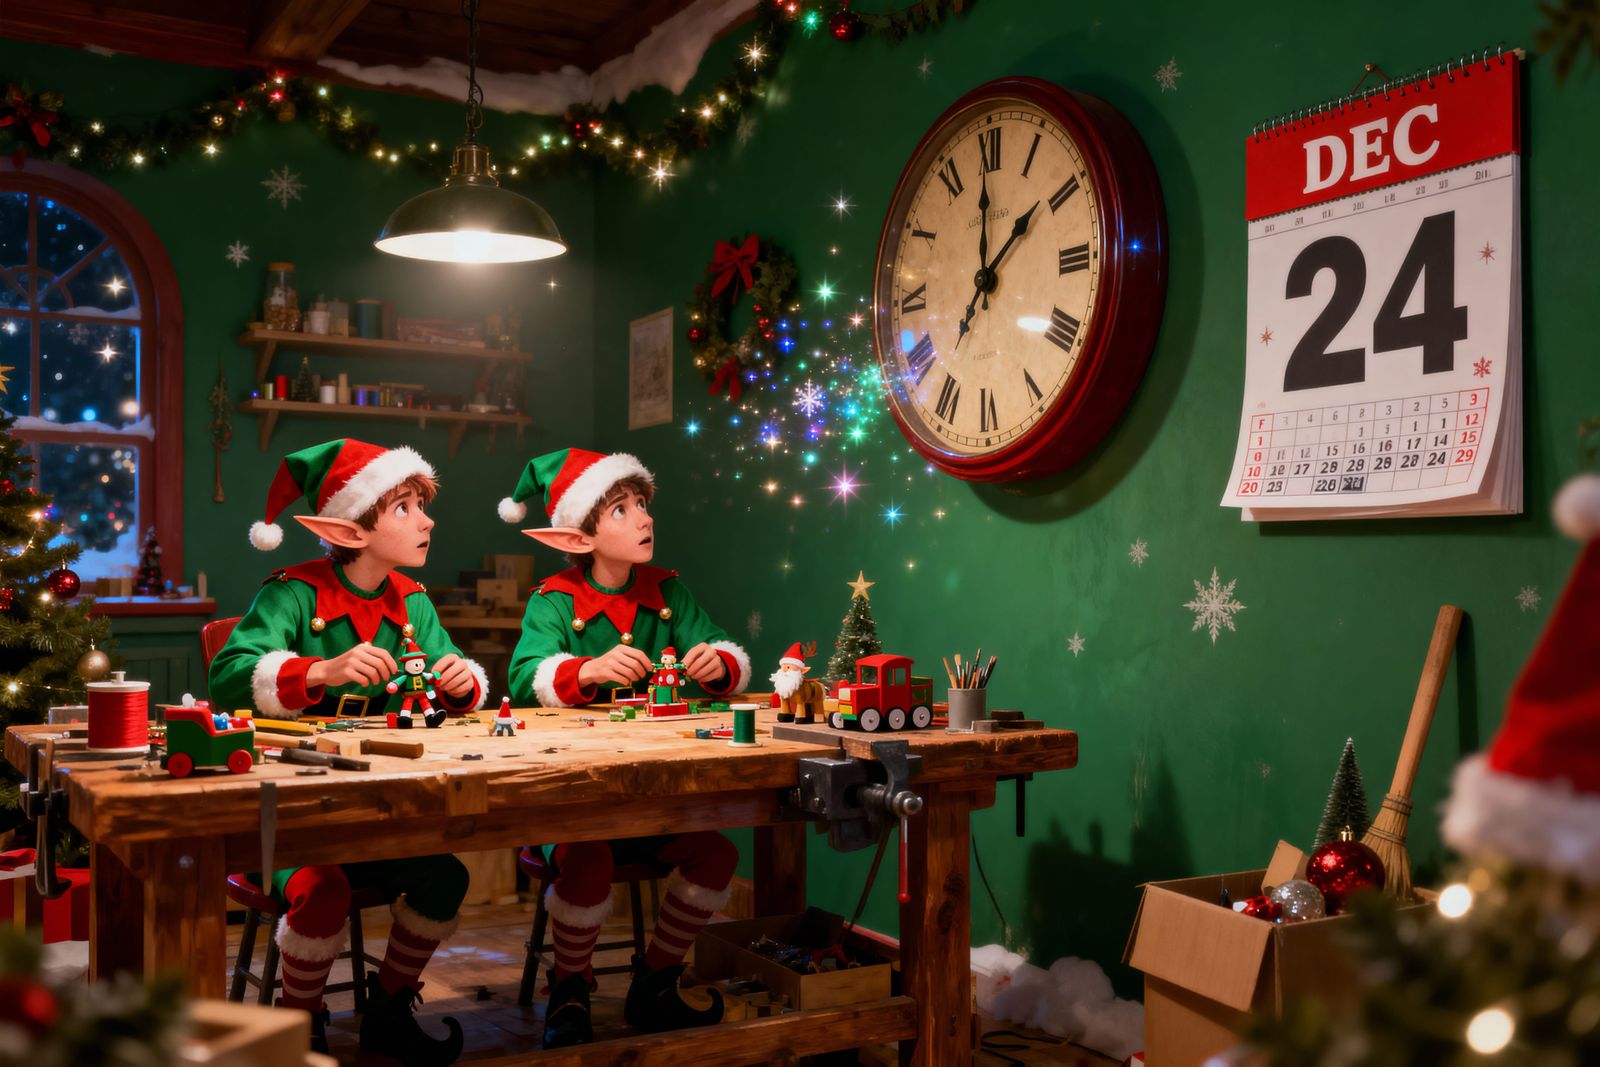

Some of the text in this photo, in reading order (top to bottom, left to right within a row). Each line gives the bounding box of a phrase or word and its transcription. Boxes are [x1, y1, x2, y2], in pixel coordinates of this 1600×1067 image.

[978, 127, 1002, 175] XII
[1021, 133, 1042, 178] I
[1303, 103, 1440, 194] DEC
[938, 158, 965, 206] XI
[1048, 173, 1080, 216] II
[912, 217, 938, 251] X
[1059, 239, 1089, 279] III
[901, 283, 926, 315] IX
[1283, 210, 1468, 392] 24
[1465, 412, 1479, 426] 12
[1455, 448, 1473, 463] 29
